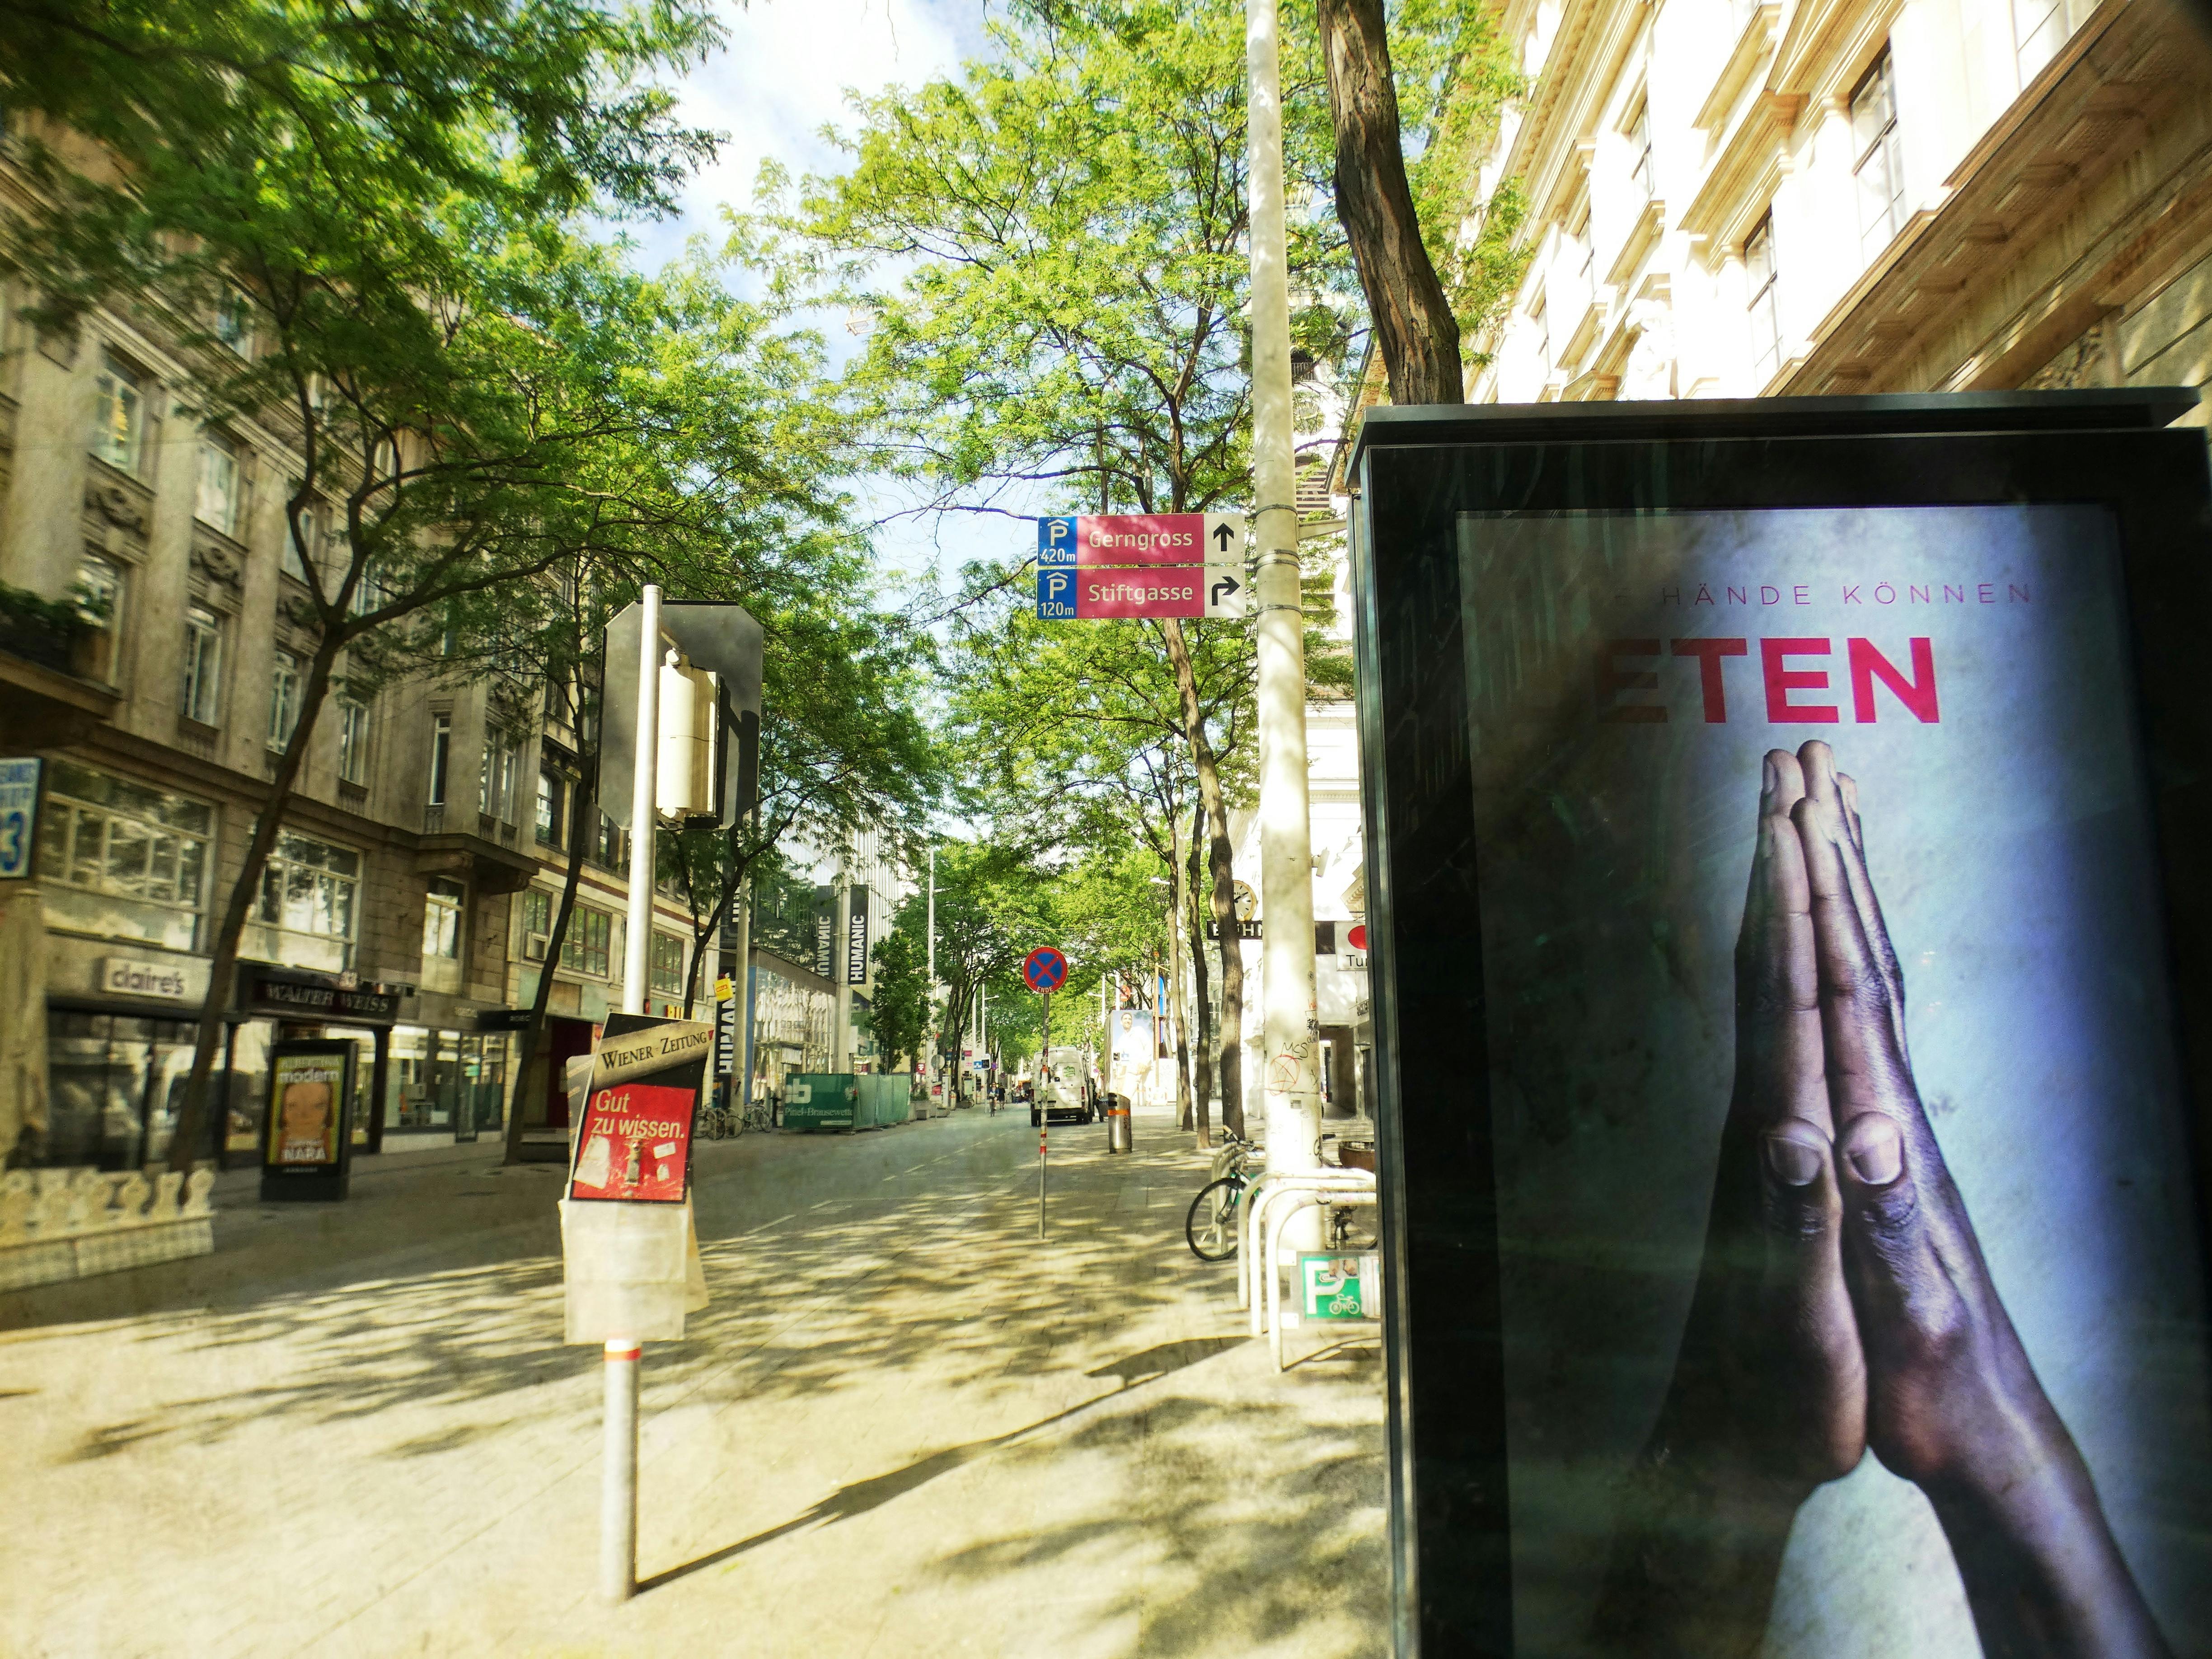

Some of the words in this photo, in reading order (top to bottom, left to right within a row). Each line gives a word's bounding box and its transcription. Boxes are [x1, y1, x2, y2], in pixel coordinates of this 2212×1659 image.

[1050, 525, 1068, 546] P
[1089, 531, 1193, 551] Gerngross
[1040, 548, 1076, 562] 420m
[1049, 578, 1067, 600] P
[1088, 584, 1193, 605] Stiftgasse
[1663, 581, 1812, 606] HÄNDE
[1843, 581, 2031, 605] KÖNNEN
[1040, 601, 1074, 616] 120m
[850, 915, 865, 981] HUMANIC
[601, 1046, 653, 1070] WIENER
[660, 1032, 707, 1055] ZEITUNG
[279, 1068, 340, 1083] modern
[595, 1089, 630, 1113] Gut
[591, 1117, 615, 1135] zu
[619, 1113, 685, 1139] wissen.
